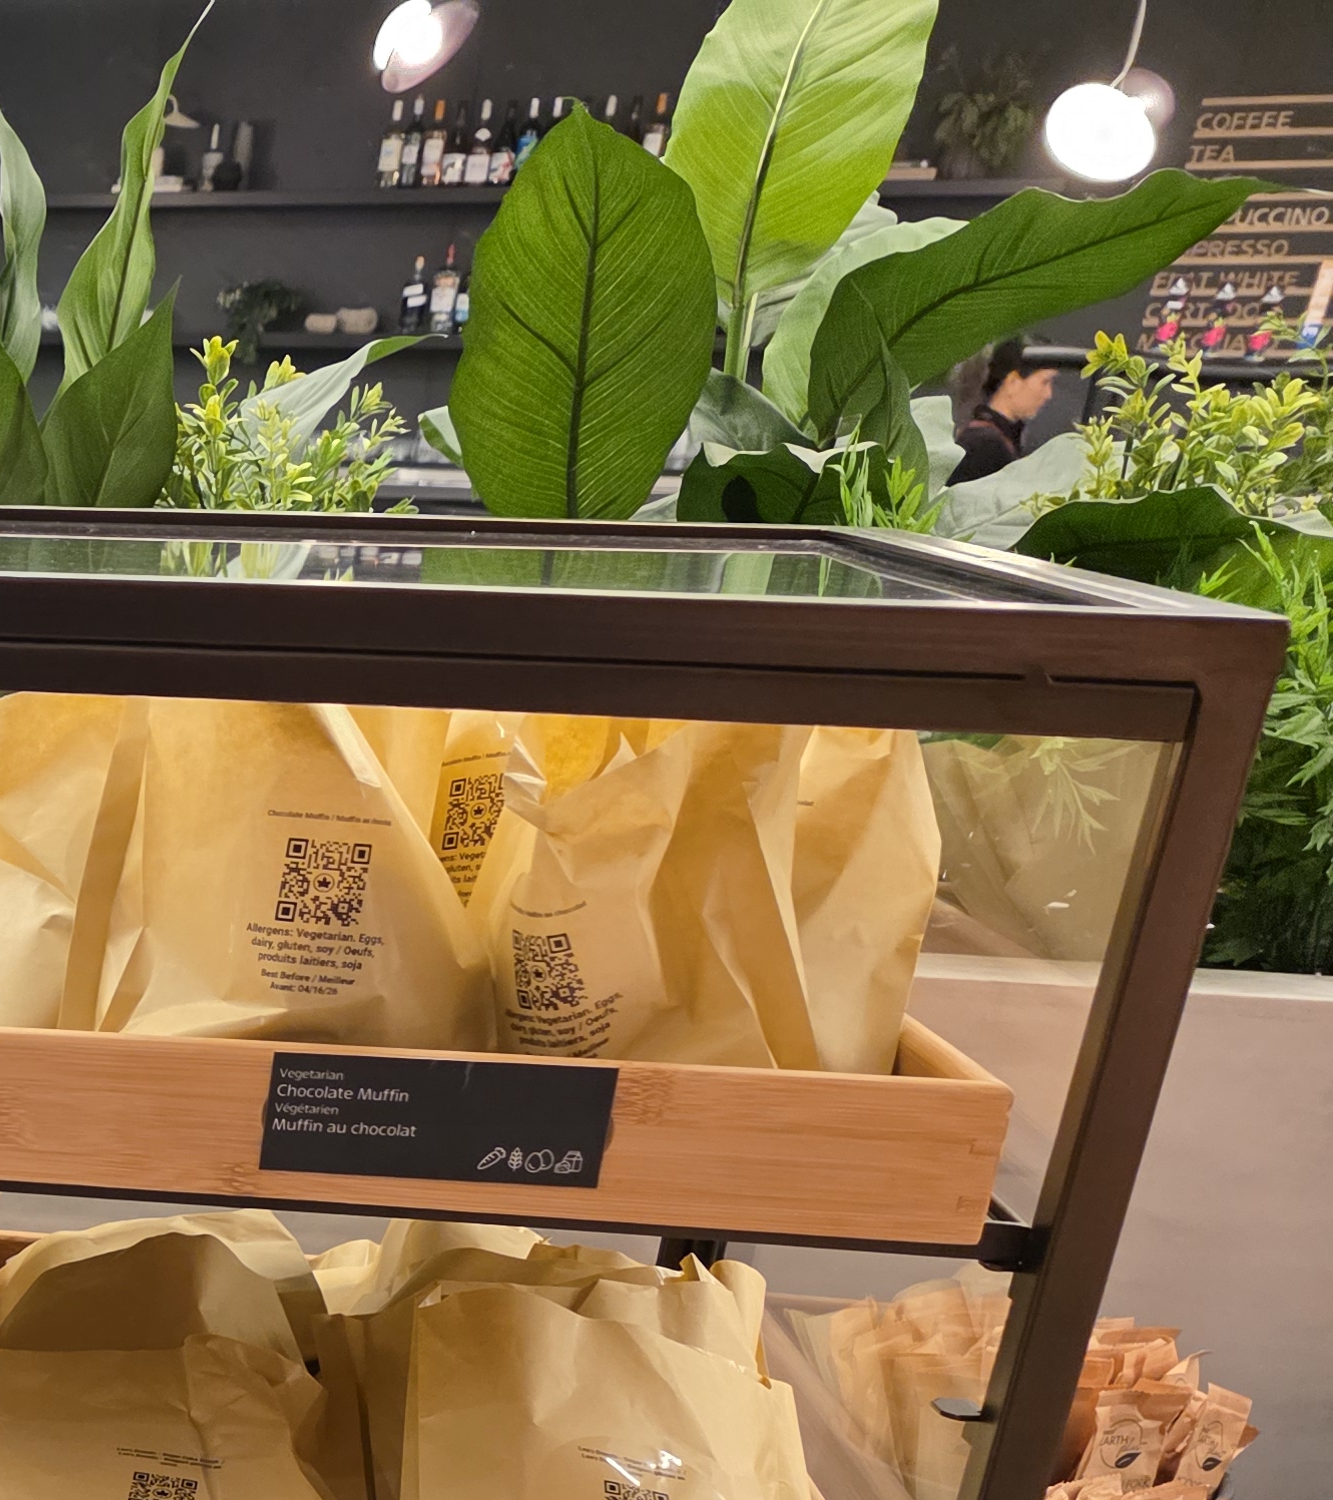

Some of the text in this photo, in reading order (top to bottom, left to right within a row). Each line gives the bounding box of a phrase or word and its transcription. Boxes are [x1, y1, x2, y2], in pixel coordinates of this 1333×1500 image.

[1196, 111, 1294, 130] COFFEE
[1190, 144, 1235, 163] TEA
[1236, 206, 1330, 226] UCCINO
[280, 1068, 344, 1080] Vegetarian
[277, 1084, 409, 1102] Chocolate Muffin
[275, 1103, 339, 1115] Végétarien
[272, 1118, 416, 1137] Muffin au chocolat
